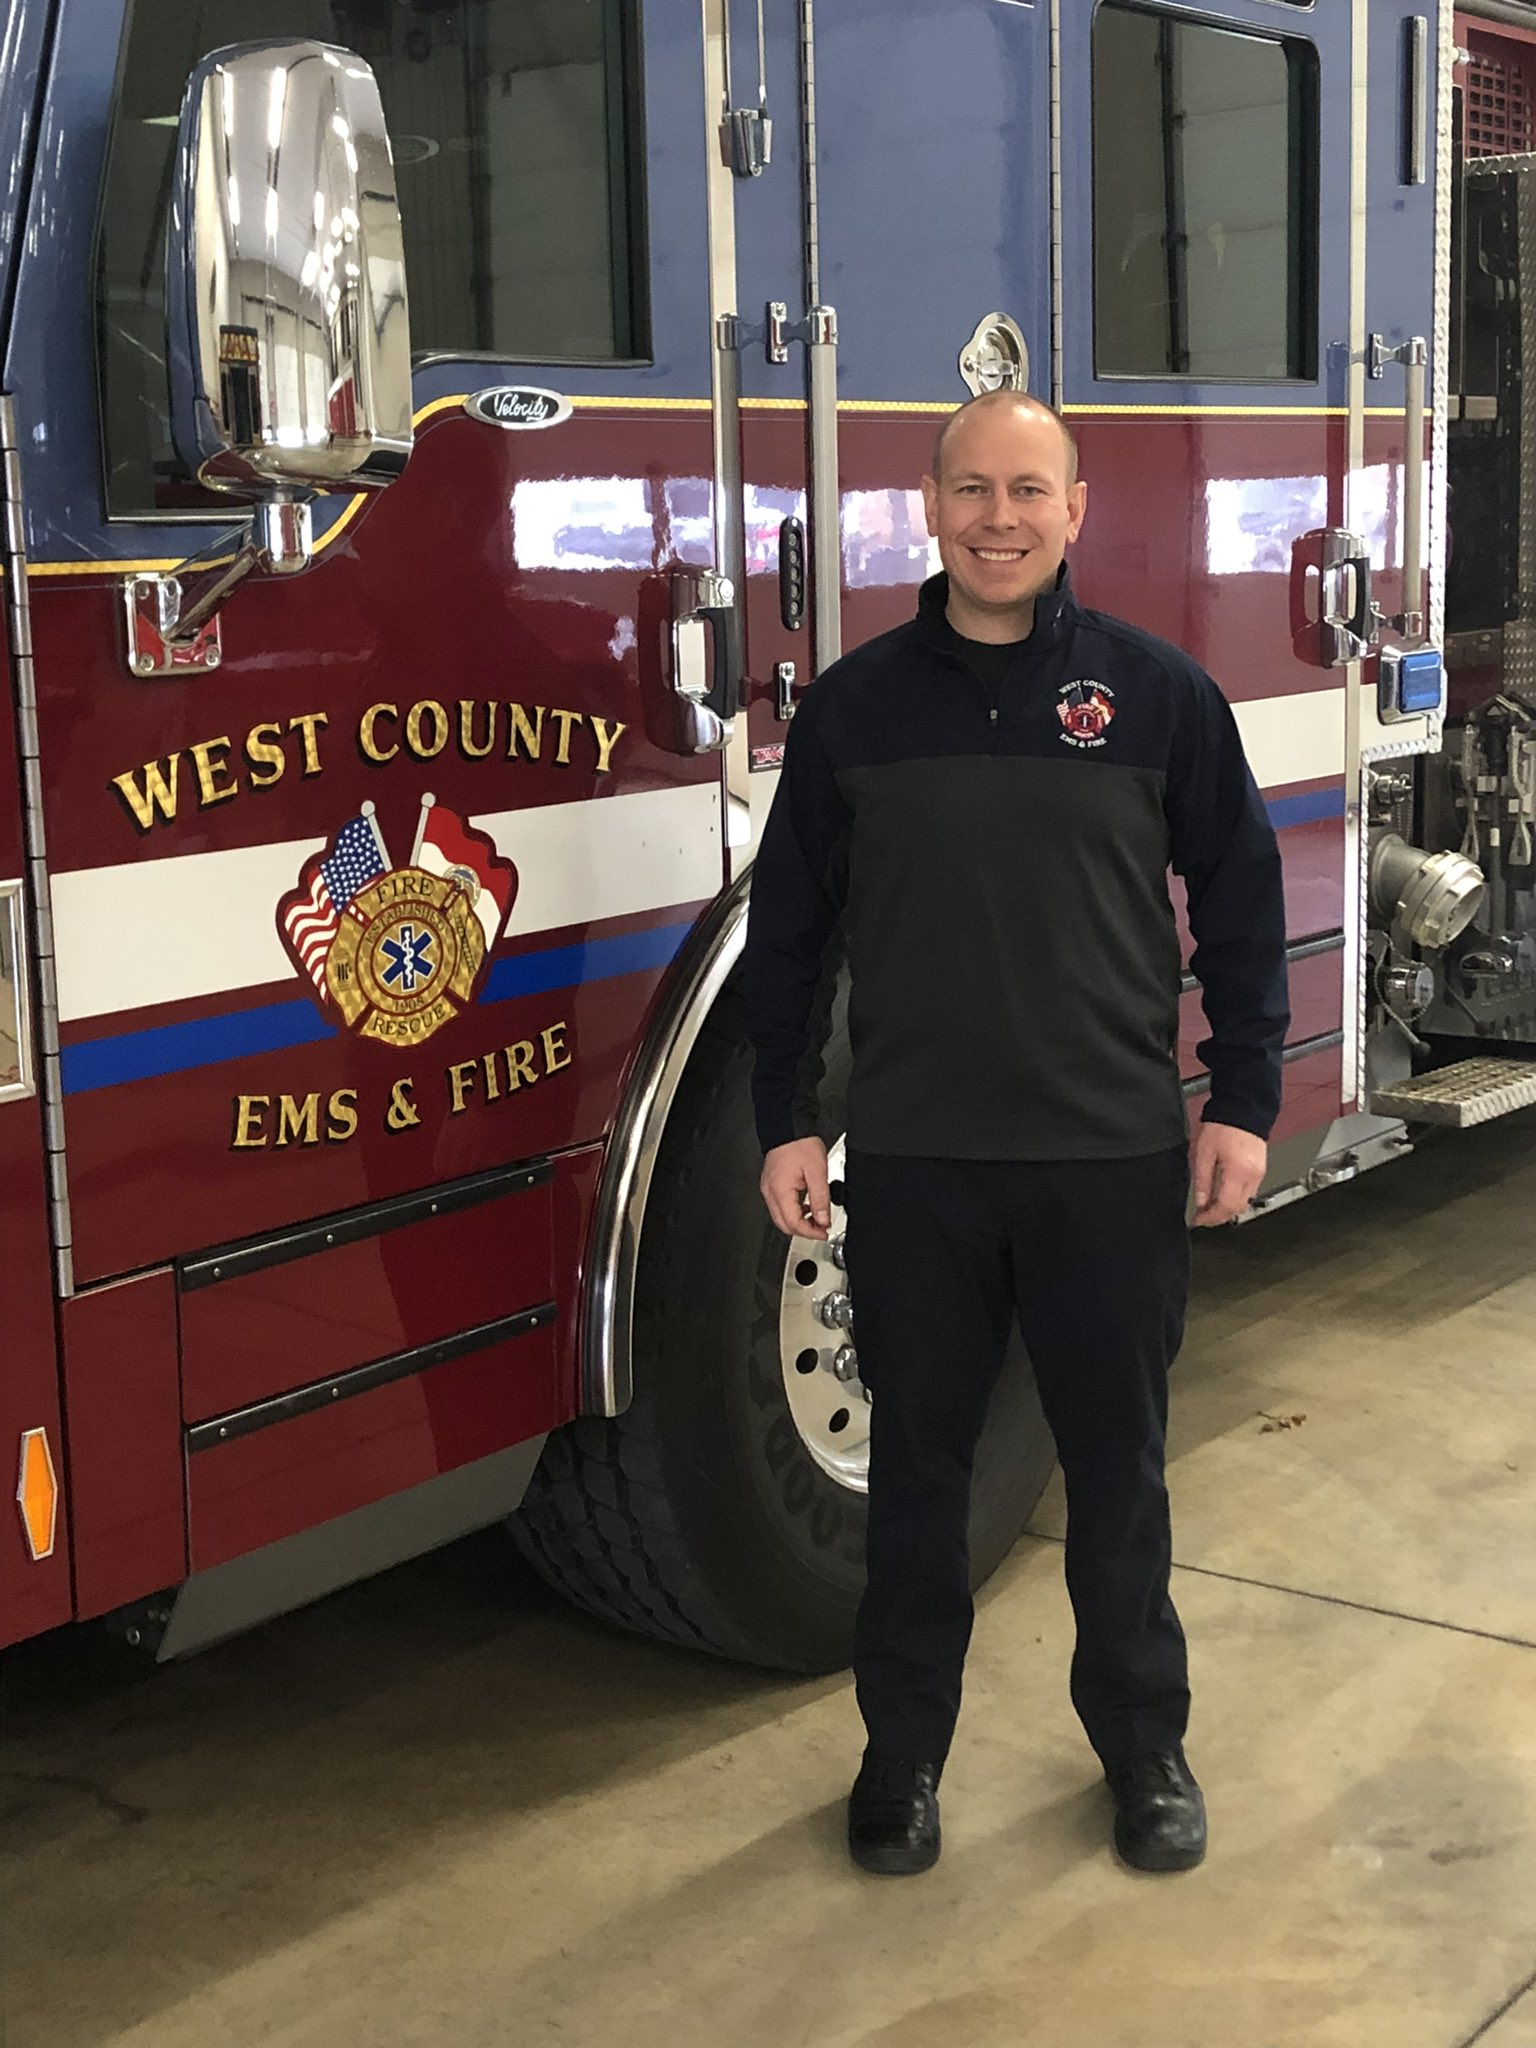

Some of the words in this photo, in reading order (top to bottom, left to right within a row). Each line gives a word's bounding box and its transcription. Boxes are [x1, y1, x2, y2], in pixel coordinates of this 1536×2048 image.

[494, 392, 549, 421] Velocity
[1059, 680, 1082, 693] WEST
[110, 712, 329, 836] WEST
[358, 699, 628, 774] COUNTY
[374, 876, 434, 904] FIRE
[365, 903, 445, 945] ESTABLISHED
[372, 1003, 446, 1037] RESCUE
[231, 1089, 359, 1150] EMS
[386, 1077, 421, 1134] &
[448, 1021, 573, 1115] FIRE
